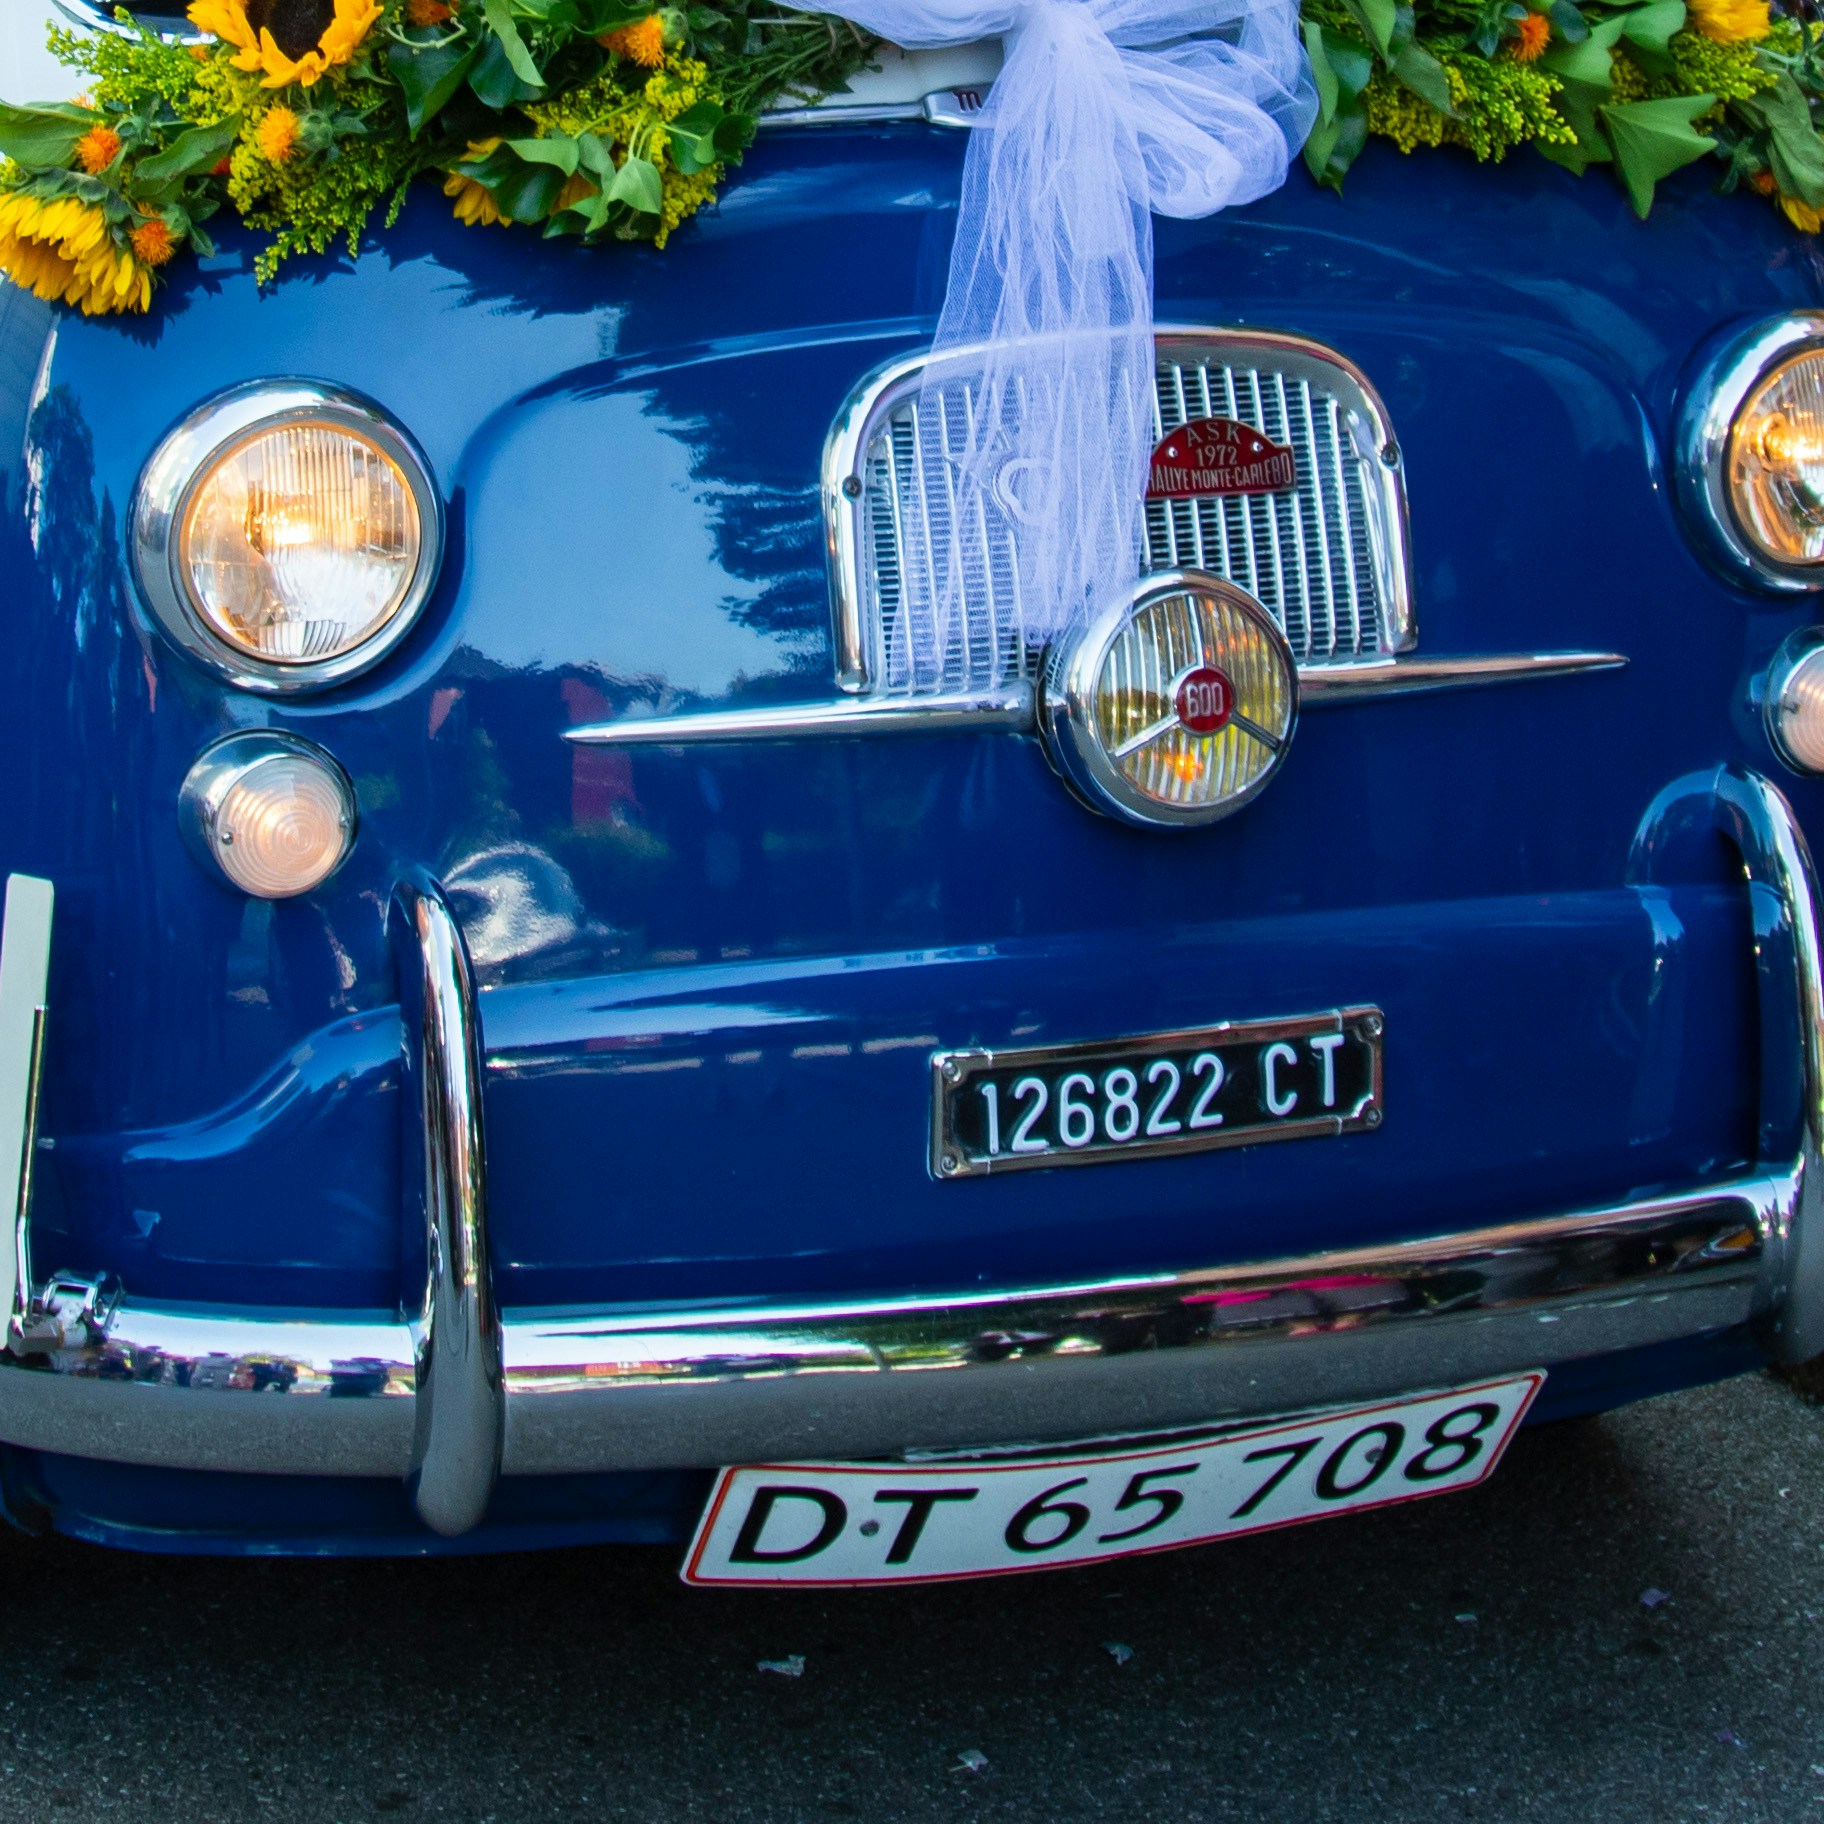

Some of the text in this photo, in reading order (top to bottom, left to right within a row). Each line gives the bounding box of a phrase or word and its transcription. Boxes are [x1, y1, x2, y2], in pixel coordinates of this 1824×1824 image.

[1185, 422, 1242, 447] ASK
[1196, 444, 1238, 467] 1972
[1185, 682, 1224, 717] 600
[981, 1033, 1346, 1156] 126822 CT
[727, 1402, 1502, 1566] DT 65 708
